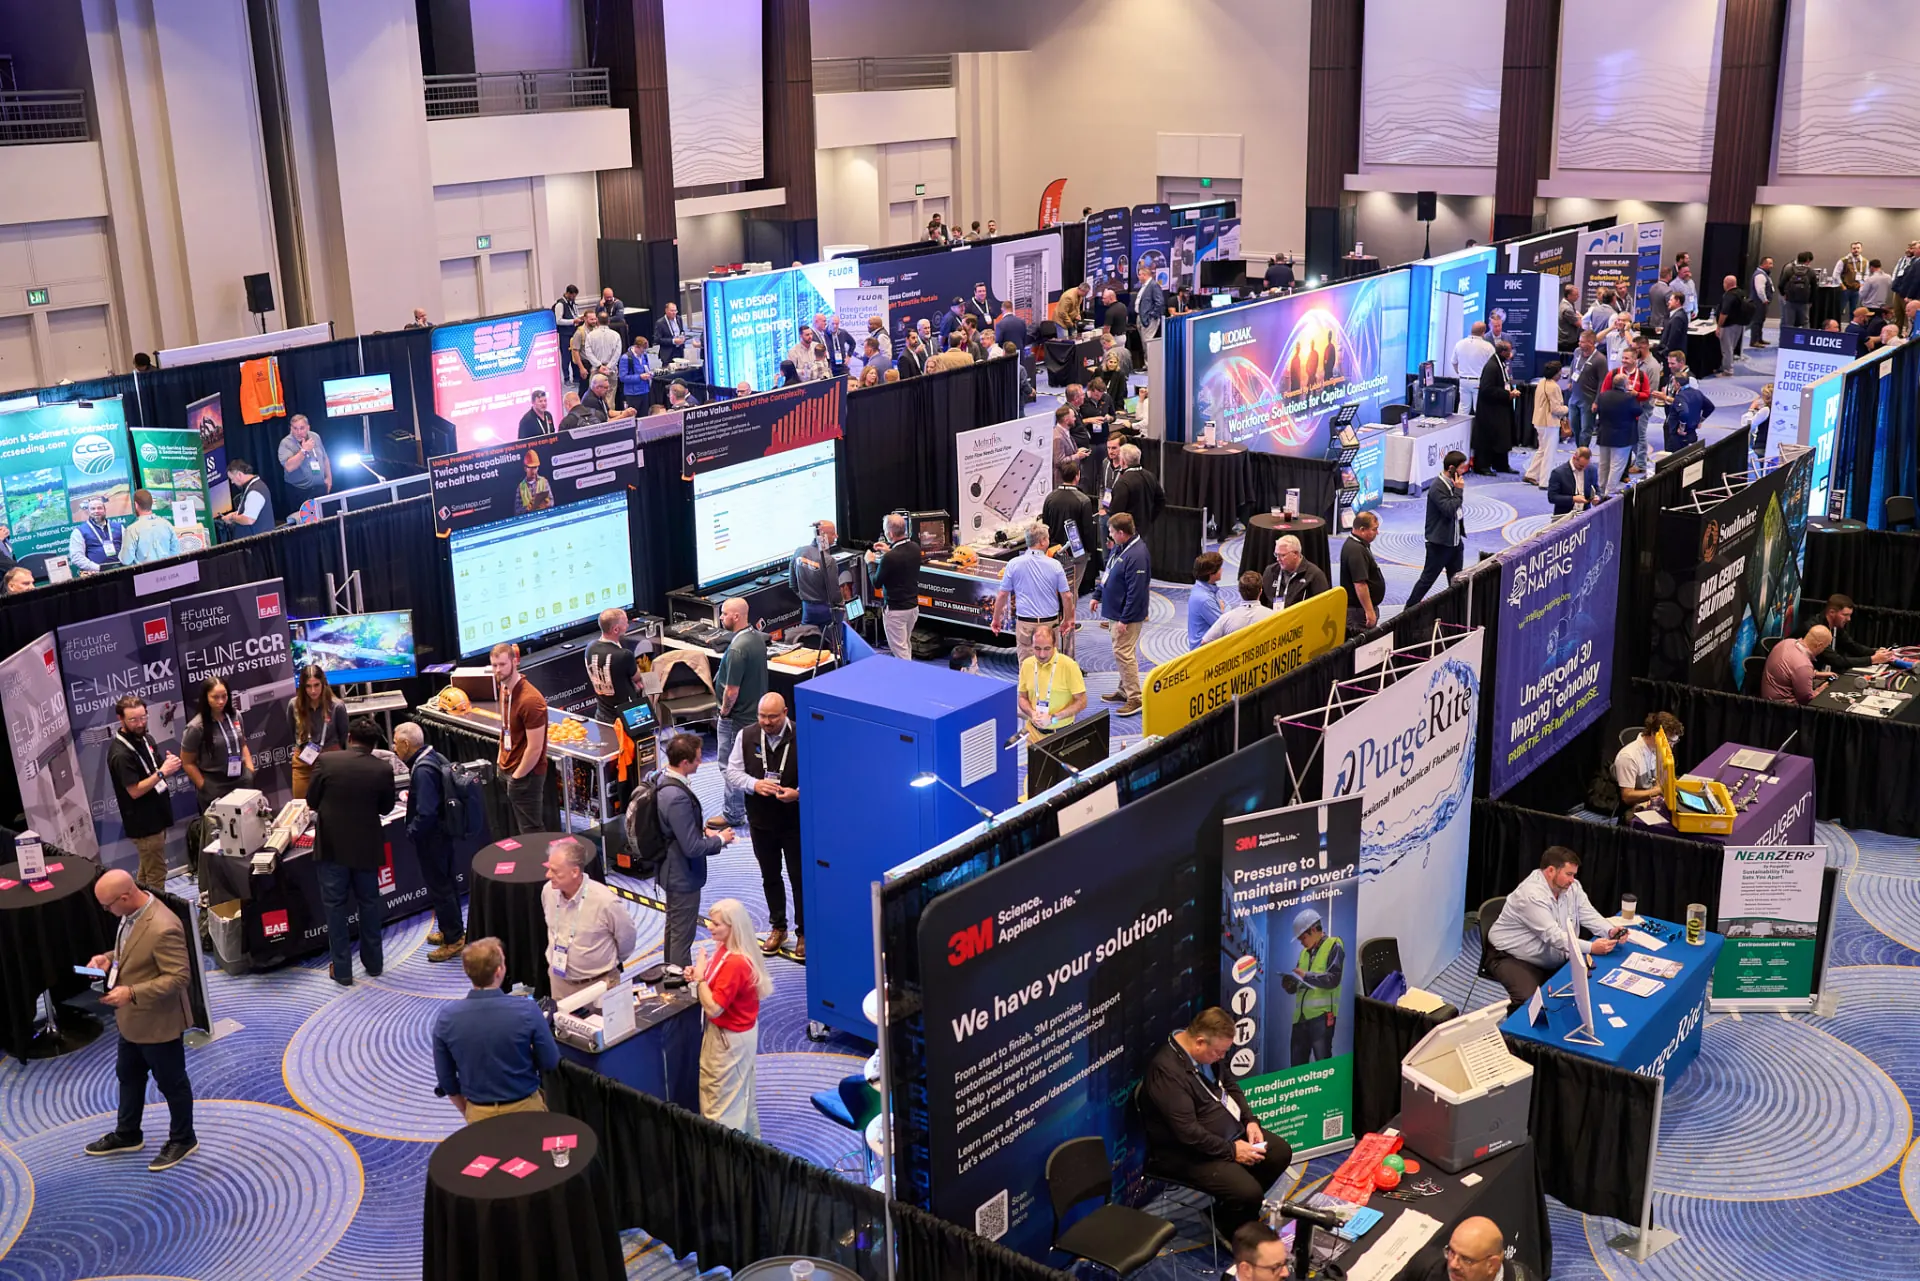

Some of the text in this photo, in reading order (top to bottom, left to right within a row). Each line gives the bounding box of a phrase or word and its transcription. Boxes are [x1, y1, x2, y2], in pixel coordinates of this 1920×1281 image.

[729, 293, 777, 310] WE DESIGN
[839, 305, 878, 315] Integrated
[730, 308, 777, 324] AND BUILD
[839, 313, 855, 321] Data
[731, 318, 793, 339] DATA CENTERS
[1222, 326, 1252, 345] KODIAK
[1810, 336, 1842, 348] LOCKE
[1788, 360, 1806, 372] GET
[686, 388, 807, 420] All the Value. None of the Complexity.
[1229, 413, 1269, 433] Workforce
[1271, 400, 1307, 420] Solutions
[1308, 394, 1320, 408] for
[1321, 385, 1346, 404] Capital
[1347, 374, 1388, 395] Construction
[20, 423, 118, 442] & Sediment Contractor
[75, 442, 110, 454] CCS
[432, 459, 449, 467] Using
[505, 446, 514, 454] you
[433, 453, 521, 478] Twice the capabilities
[434, 469, 499, 490] for half the cost
[37, 527, 59, 538] National
[1528, 557, 1572, 595] MAPPING
[1700, 555, 1746, 602] DATA CENTER
[260, 605, 279, 617] EAE
[952, 604, 980, 614] SMARTSITE
[1698, 582, 1736, 624] SOLUTIONS
[180, 605, 224, 623] #Future
[182, 613, 231, 632] Together
[66, 632, 110, 650] #Future
[147, 631, 166, 641] EAE
[67, 641, 117, 660] Together
[185, 633, 285, 670] E-LINE CCR
[1204, 625, 1304, 684] I'M THIS IS AMAZING!
[188, 653, 287, 683] BUSWAY SYSTEMS
[1520, 640, 1592, 706] Underground 3D
[71, 658, 173, 701] E-LINE KX
[1162, 669, 1191, 690] ZEBEL
[1190, 644, 1303, 718] GO SEE WHAT'S INSIDE
[1551, 661, 1600, 709] Technology
[75, 680, 175, 715] BUSWAY SYSTEMS
[566, 704, 580, 713] INTO
[1357, 686, 1471, 793] PurgeRite
[1392, 741, 1460, 799] Mechanical Flushing
[1235, 836, 1257, 851] 3M
[1259, 837, 1279, 847] Applied
[1234, 857, 1315, 884] Pressure to
[1234, 864, 1354, 902] maintain power?
[998, 896, 1043, 925] Science.
[265, 923, 288, 935] EAE
[998, 906, 1053, 944] Applied to
[948, 916, 993, 966] 3M
[952, 907, 1173, 1043] We have your solution.
[955, 1001, 1083, 1084] From start to finish, 3M provides
[1254, 1067, 1335, 1094] medium voltage
[958, 1045, 1124, 1160] Learn more at 3m.com/datacentersolutions
[1279, 1084, 1322, 1102] systems.
[1256, 1103, 1300, 1121] xpertise.
